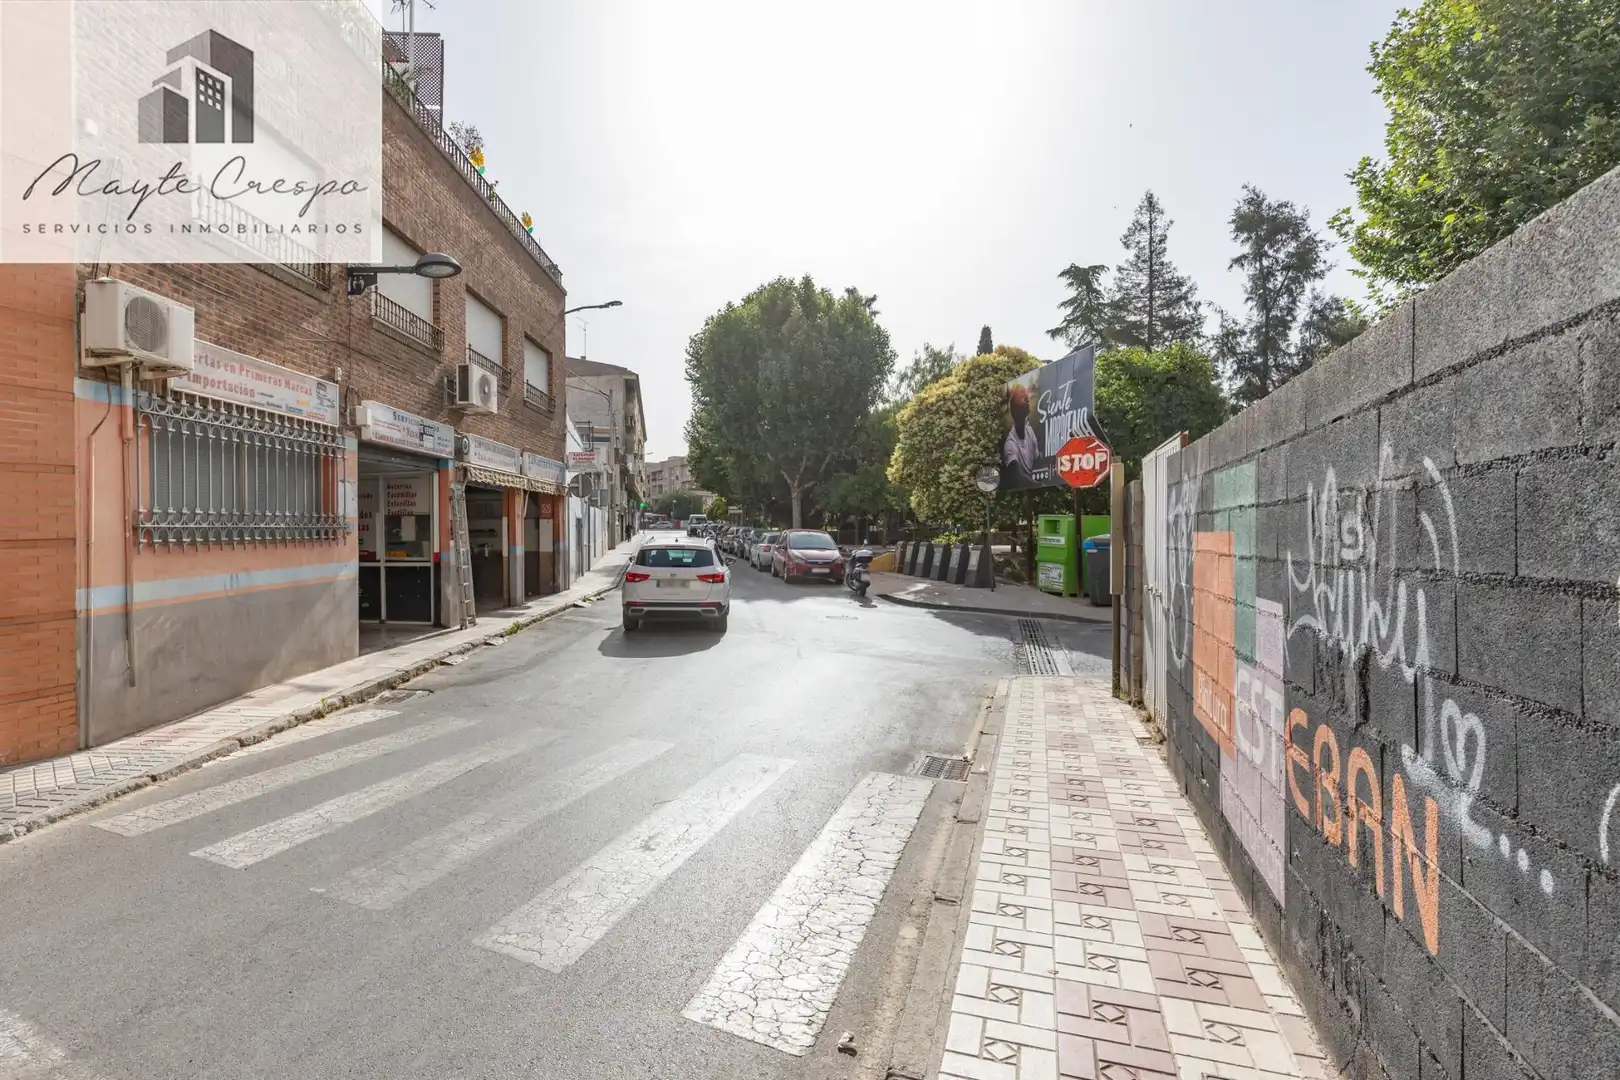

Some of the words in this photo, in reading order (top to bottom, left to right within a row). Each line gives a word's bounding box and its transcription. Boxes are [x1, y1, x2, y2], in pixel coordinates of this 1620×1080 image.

[239, 363, 282, 387] Primeras
[284, 378, 313, 396] Marcas
[1059, 451, 1107, 473] STOP
